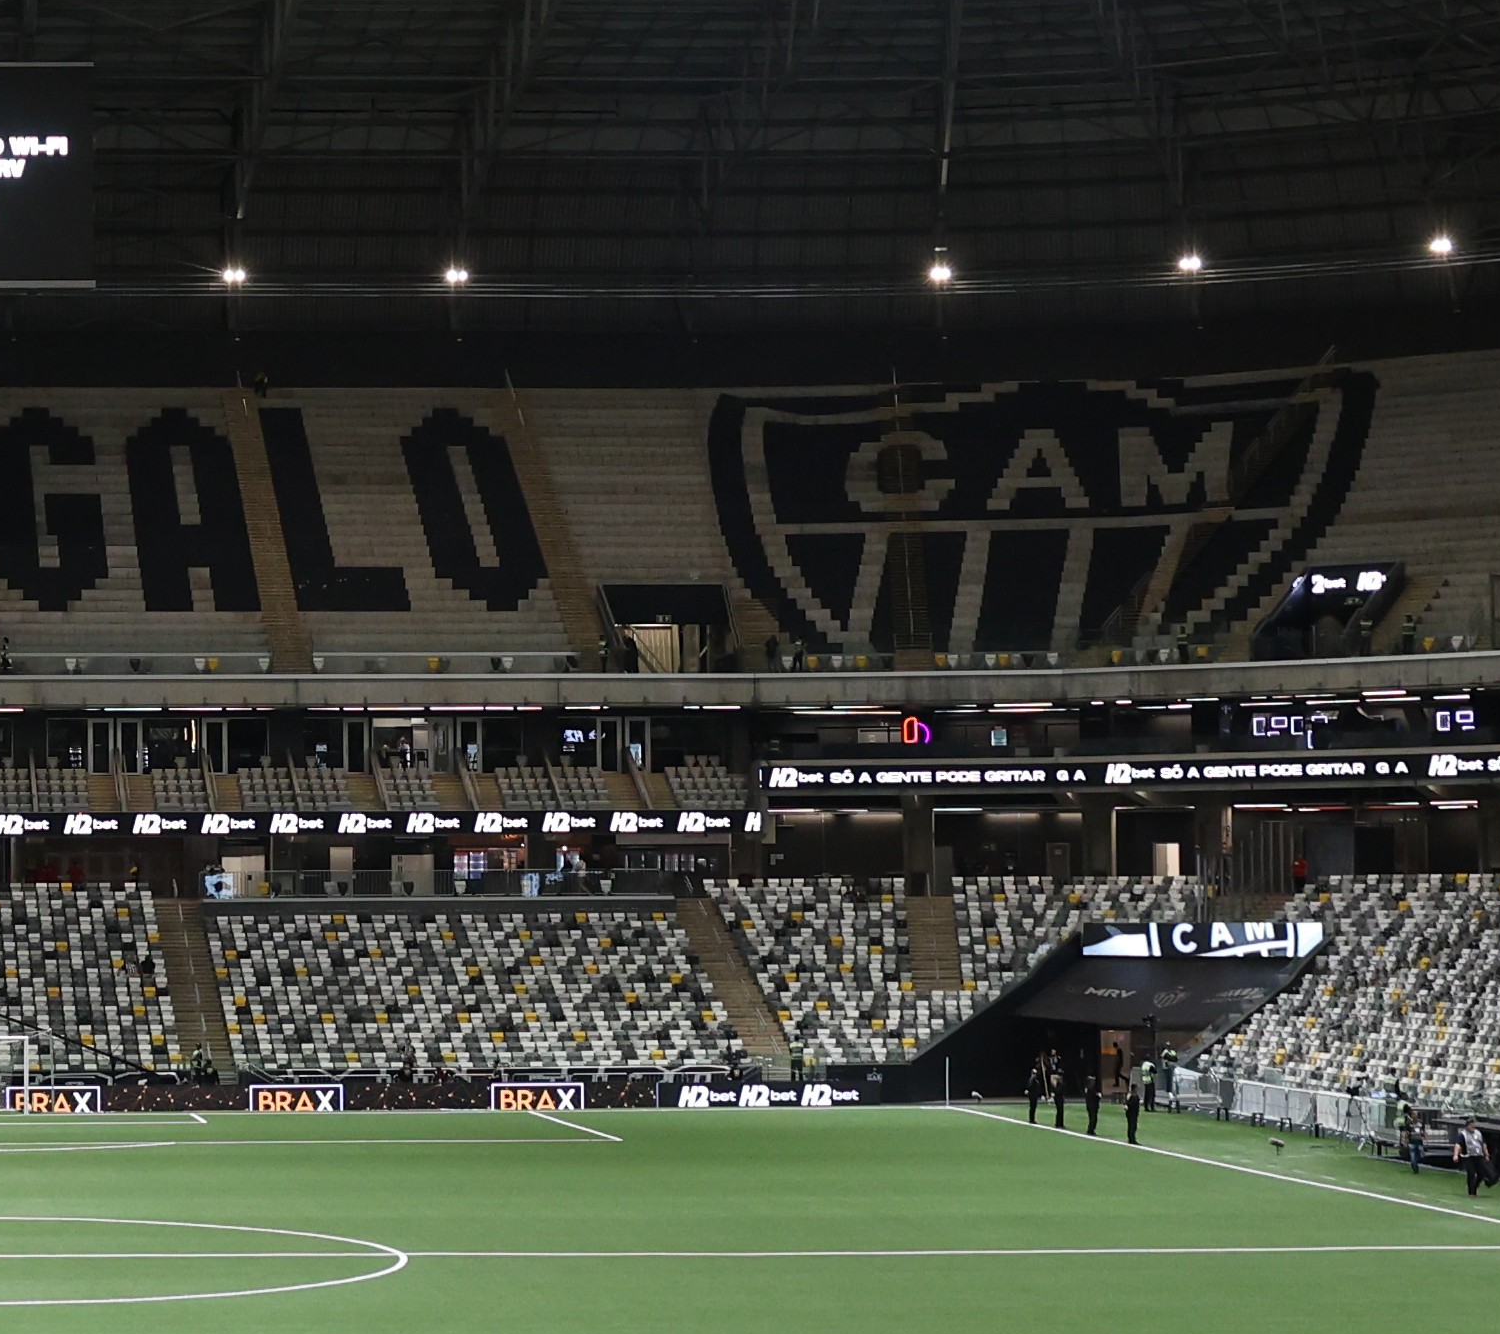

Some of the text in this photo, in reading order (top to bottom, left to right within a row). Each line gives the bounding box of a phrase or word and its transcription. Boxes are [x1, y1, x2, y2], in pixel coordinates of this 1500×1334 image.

[9, 136, 69, 156] WI-FI
[844, 422, 1235, 512] CAM
[858, 772, 873, 783] A
[876, 771, 933, 783] GENTE
[936, 771, 981, 783] PODE
[984, 770, 1046, 782] GRITAR
[1187, 767, 1200, 778] A
[1203, 766, 1257, 778] GENTE
[1259, 764, 1303, 777] PODE
[1306, 763, 1366, 776] GRITAR
[258, 1091, 335, 1112] BRAX
[500, 1090, 577, 1111] BRAX
